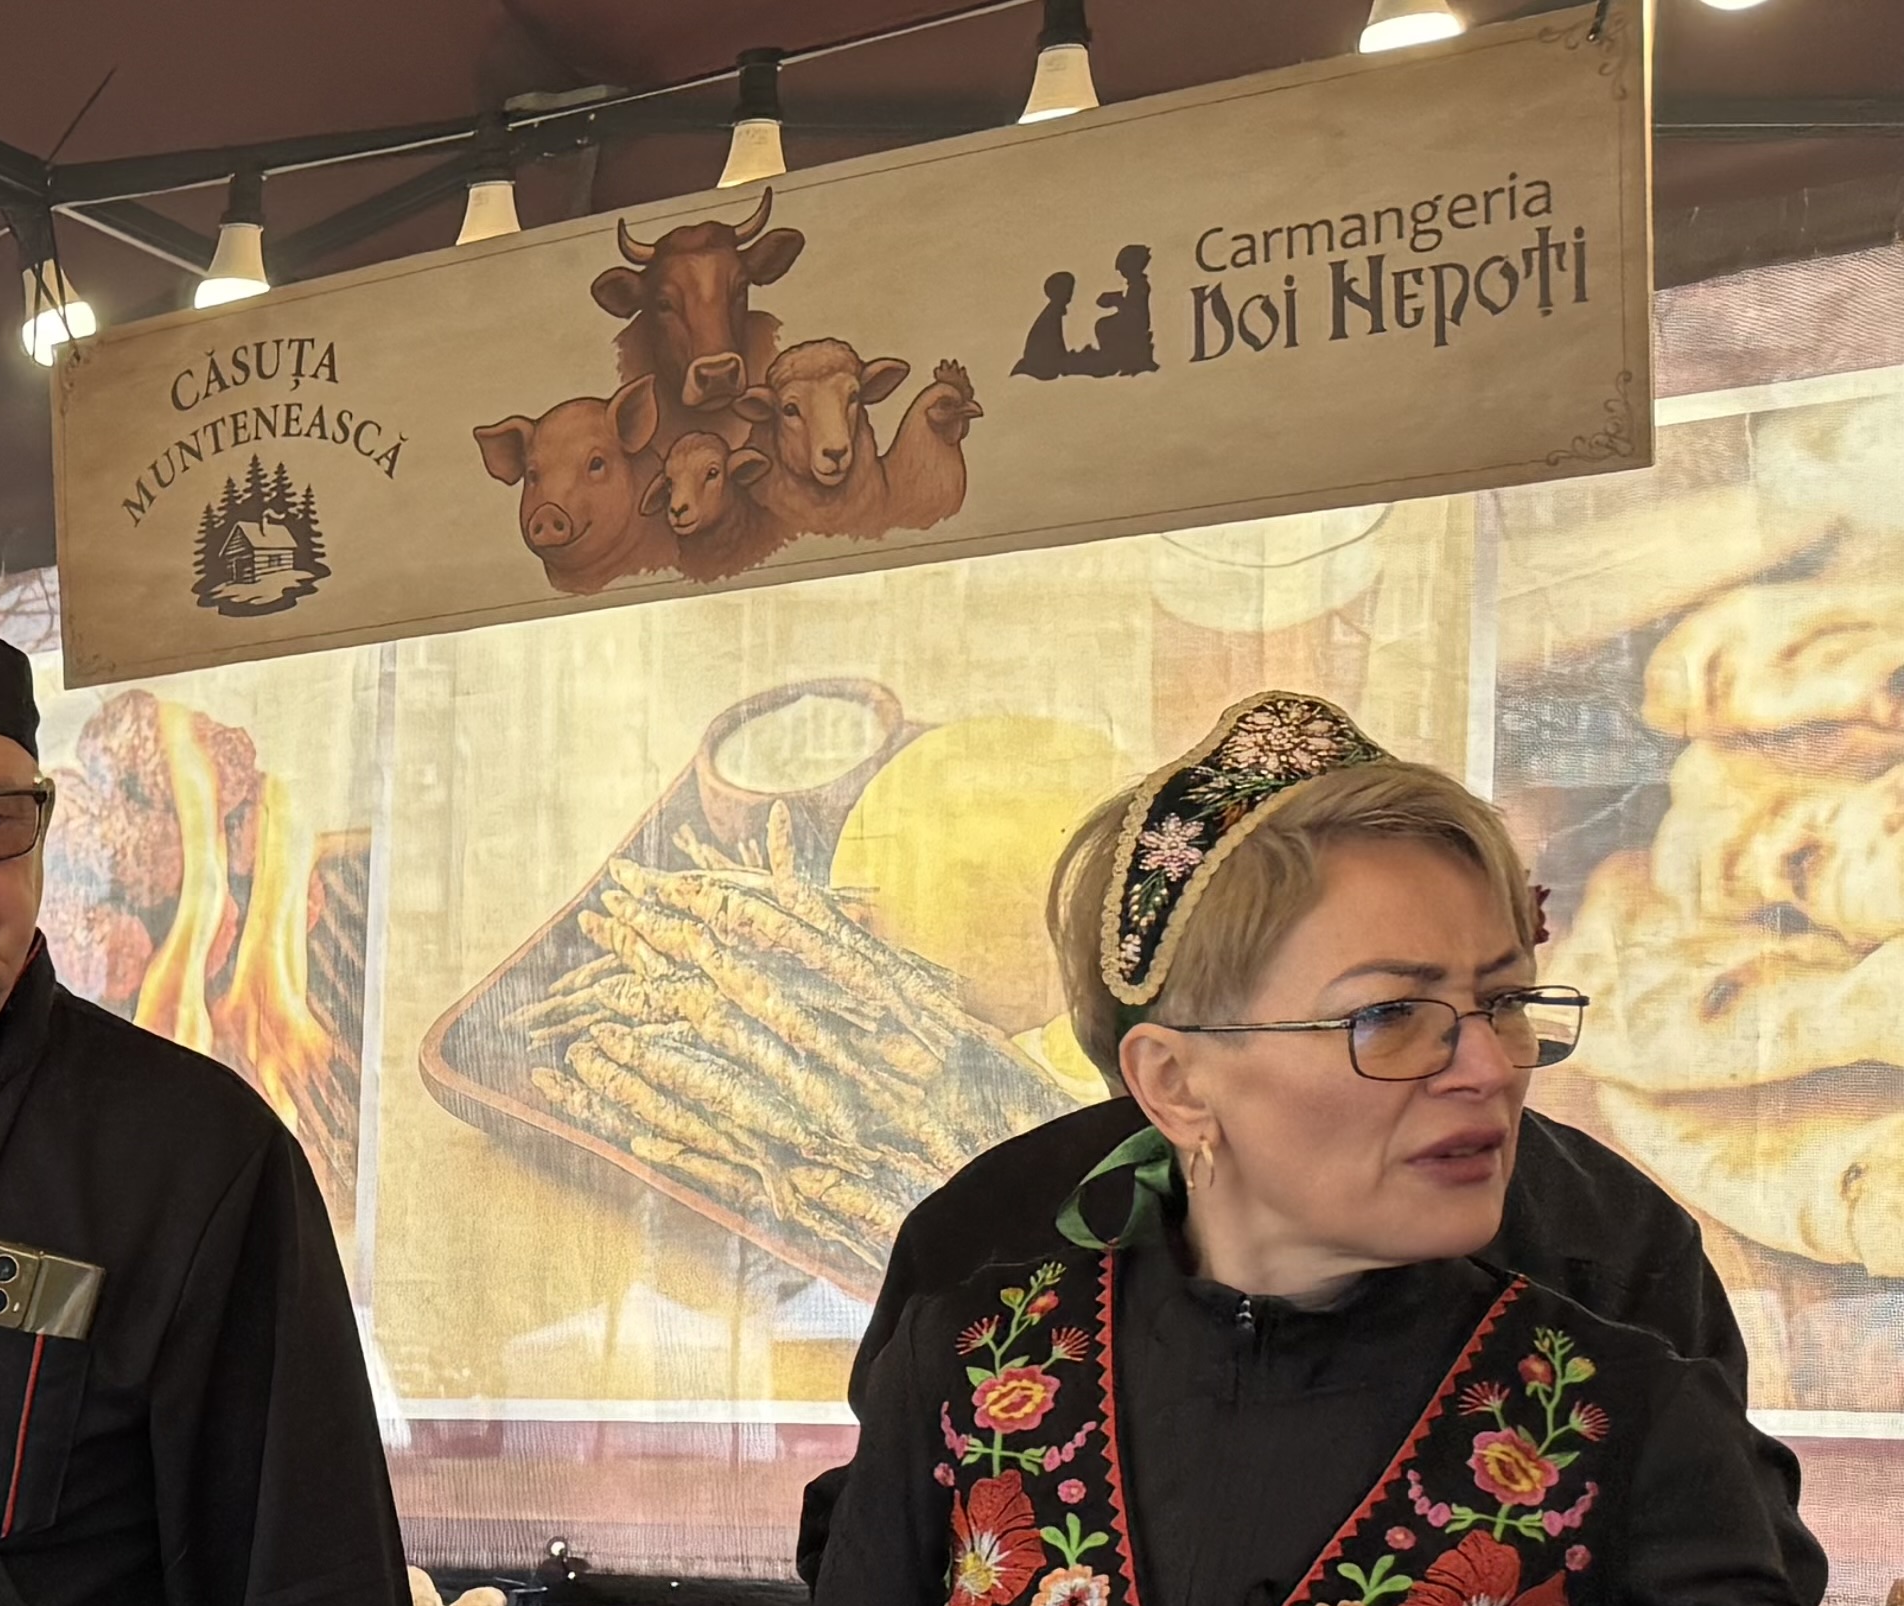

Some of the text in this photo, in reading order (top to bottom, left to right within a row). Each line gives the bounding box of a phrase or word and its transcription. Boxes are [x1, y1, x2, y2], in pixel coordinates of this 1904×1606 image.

[1194, 171, 1553, 273] Carmangeria
[1189, 273, 1300, 365] Doi
[170, 337, 340, 412] CĂSUȚA
[120, 402, 409, 528] MUNTENEASCĂ
